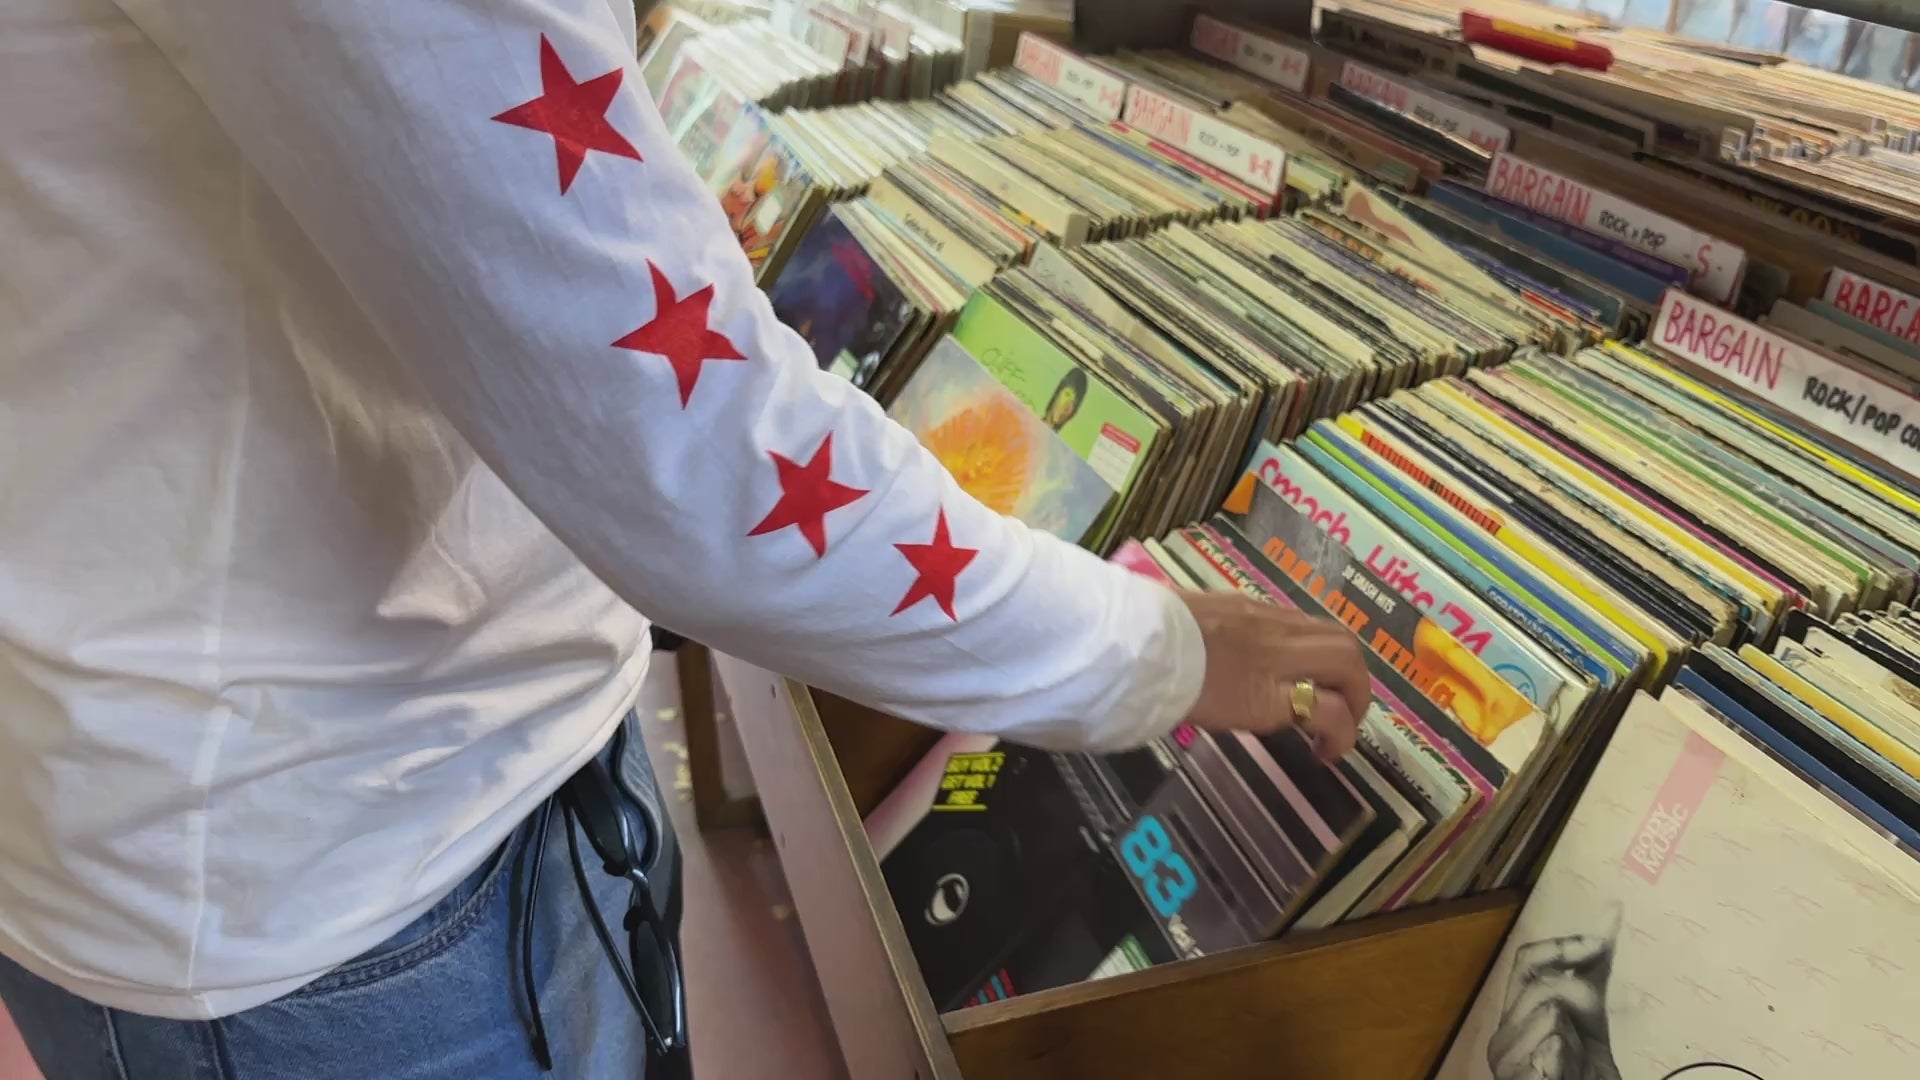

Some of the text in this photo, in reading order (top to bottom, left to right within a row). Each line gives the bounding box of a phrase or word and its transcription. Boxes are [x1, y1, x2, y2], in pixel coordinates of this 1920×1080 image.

[1492, 157, 1593, 225] BARGAIN
[1599, 210, 1630, 239] ROCK
[1639, 226, 1667, 250] POP
[1664, 300, 1784, 390] BARGAIN
[1375, 591, 1398, 615] HITS
[1119, 813, 1198, 918] 83
[1630, 802, 1668, 864] BODY
